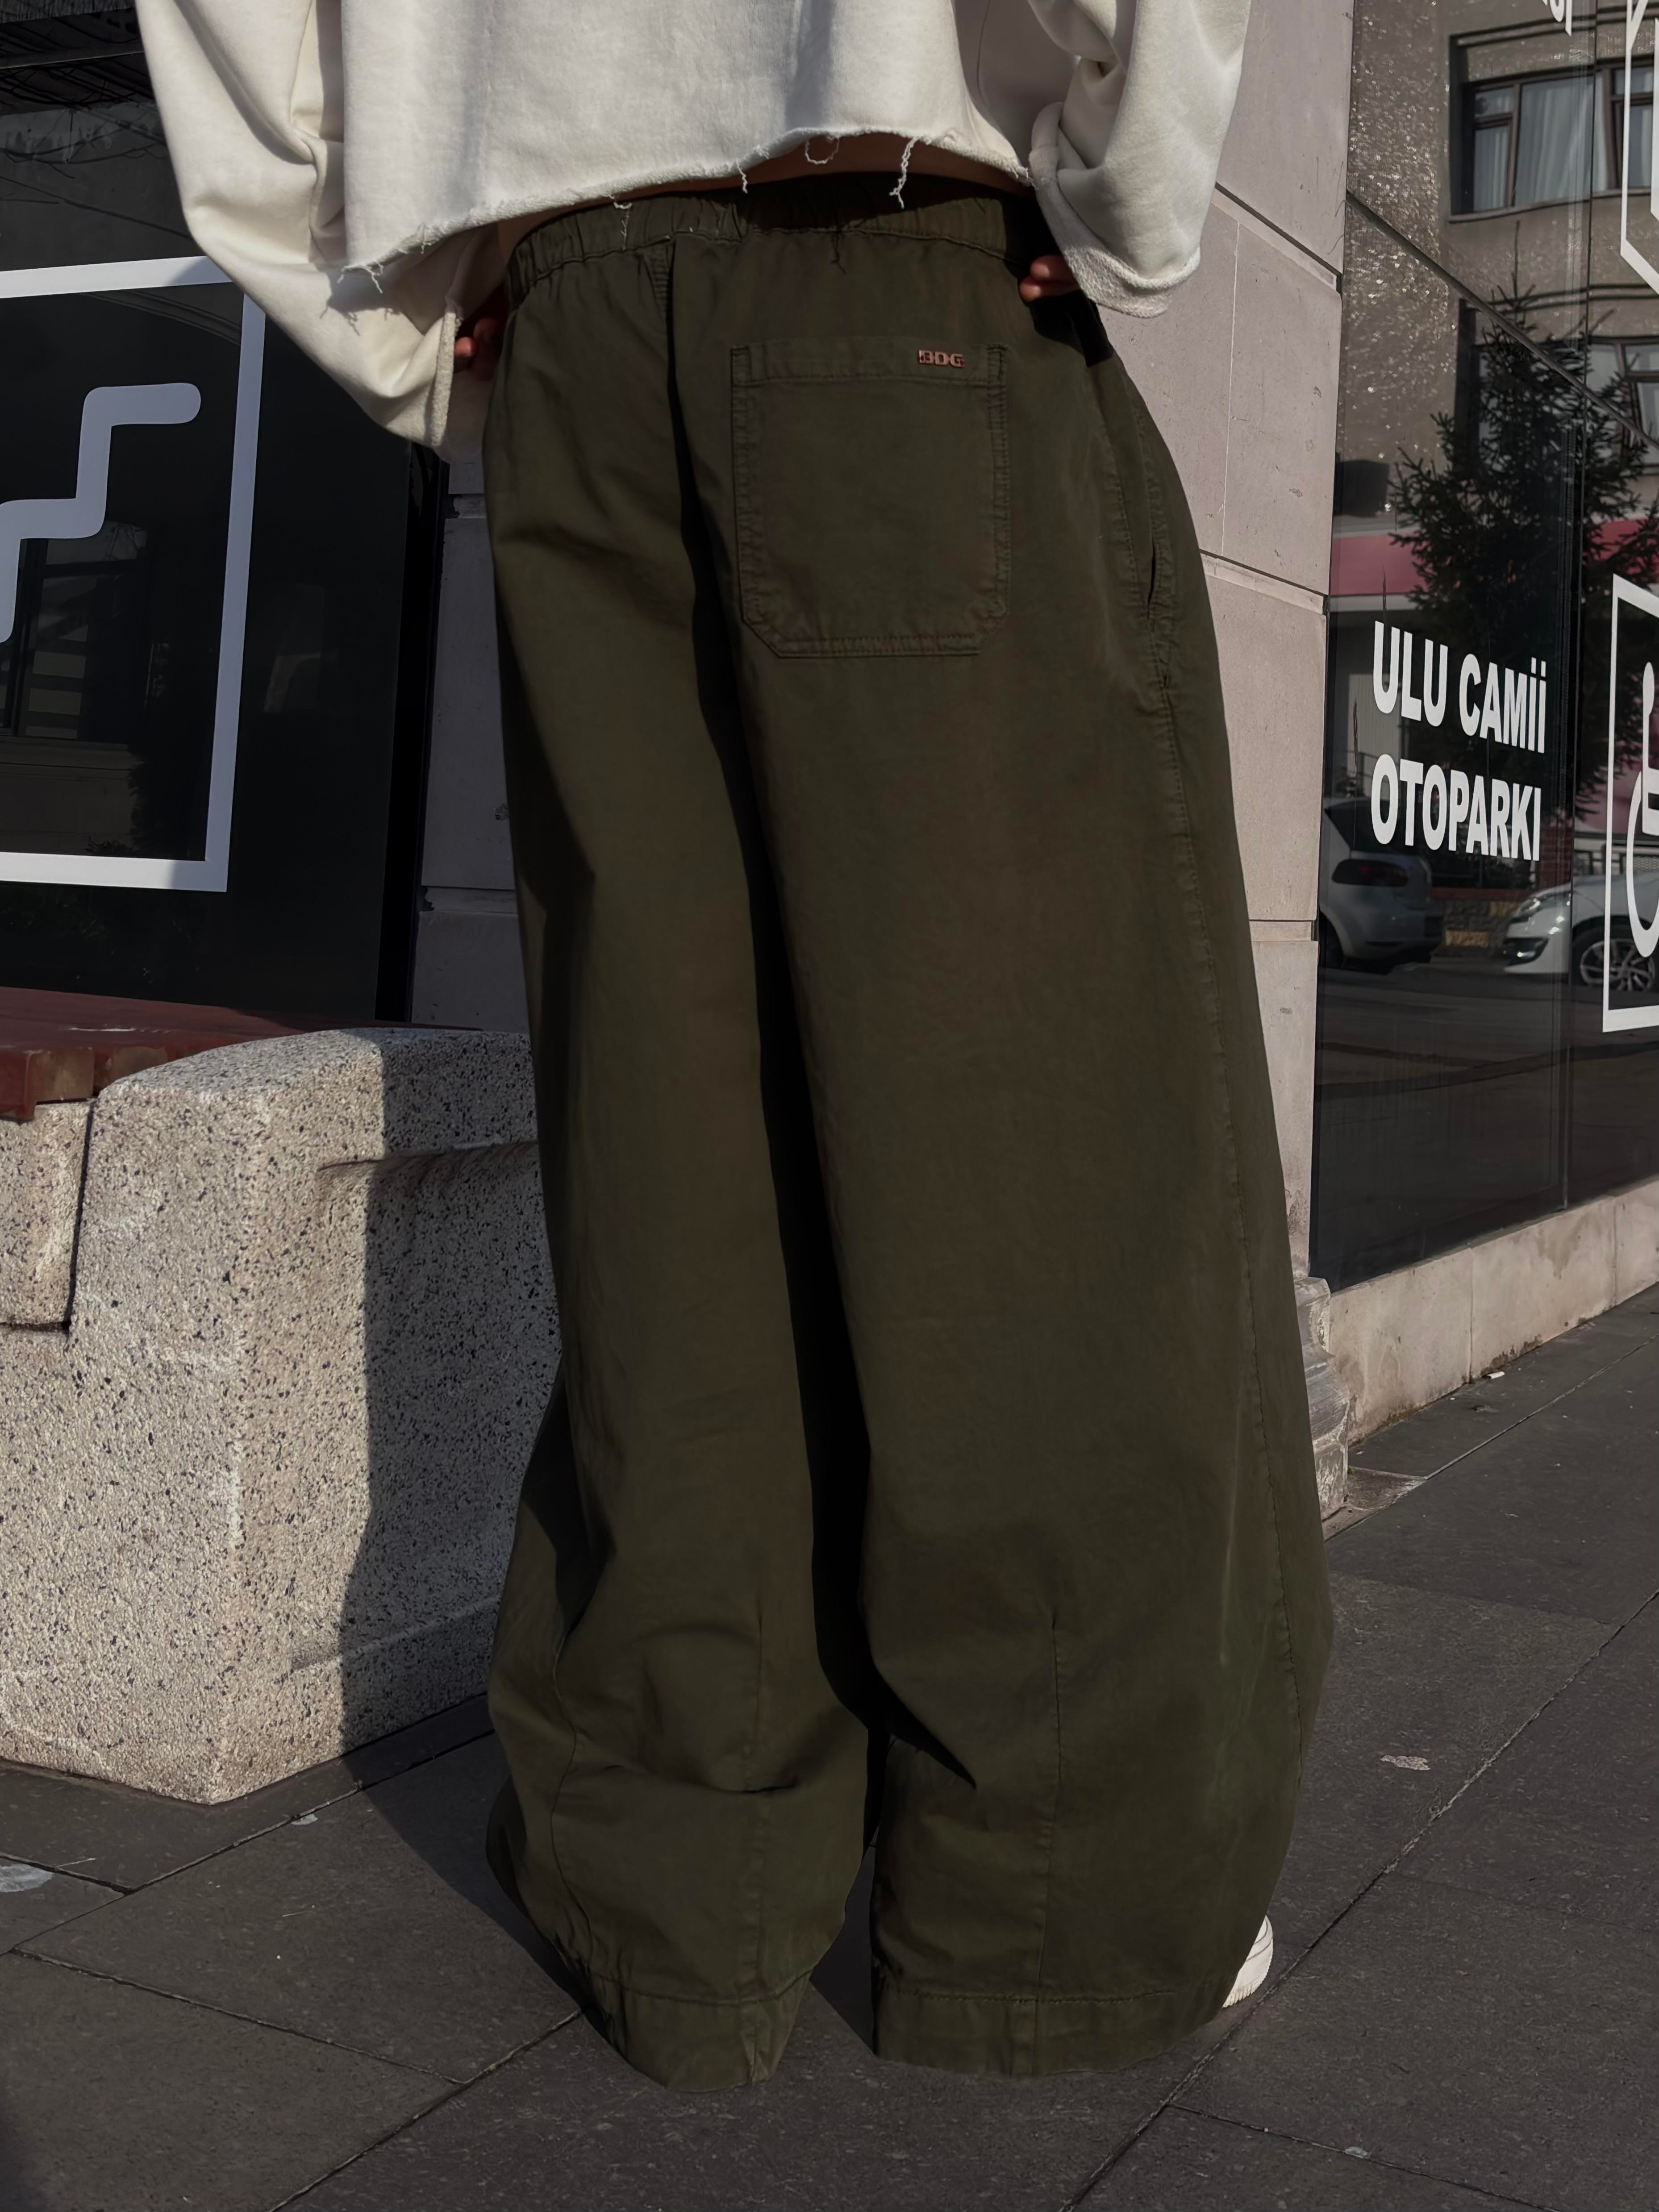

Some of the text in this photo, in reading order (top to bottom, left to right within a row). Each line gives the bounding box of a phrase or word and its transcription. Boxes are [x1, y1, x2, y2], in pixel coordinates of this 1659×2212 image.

[918, 350, 965, 368] BDG
[1373, 621, 1448, 727] ULU
[1371, 754, 1542, 861] OTOPARKI
